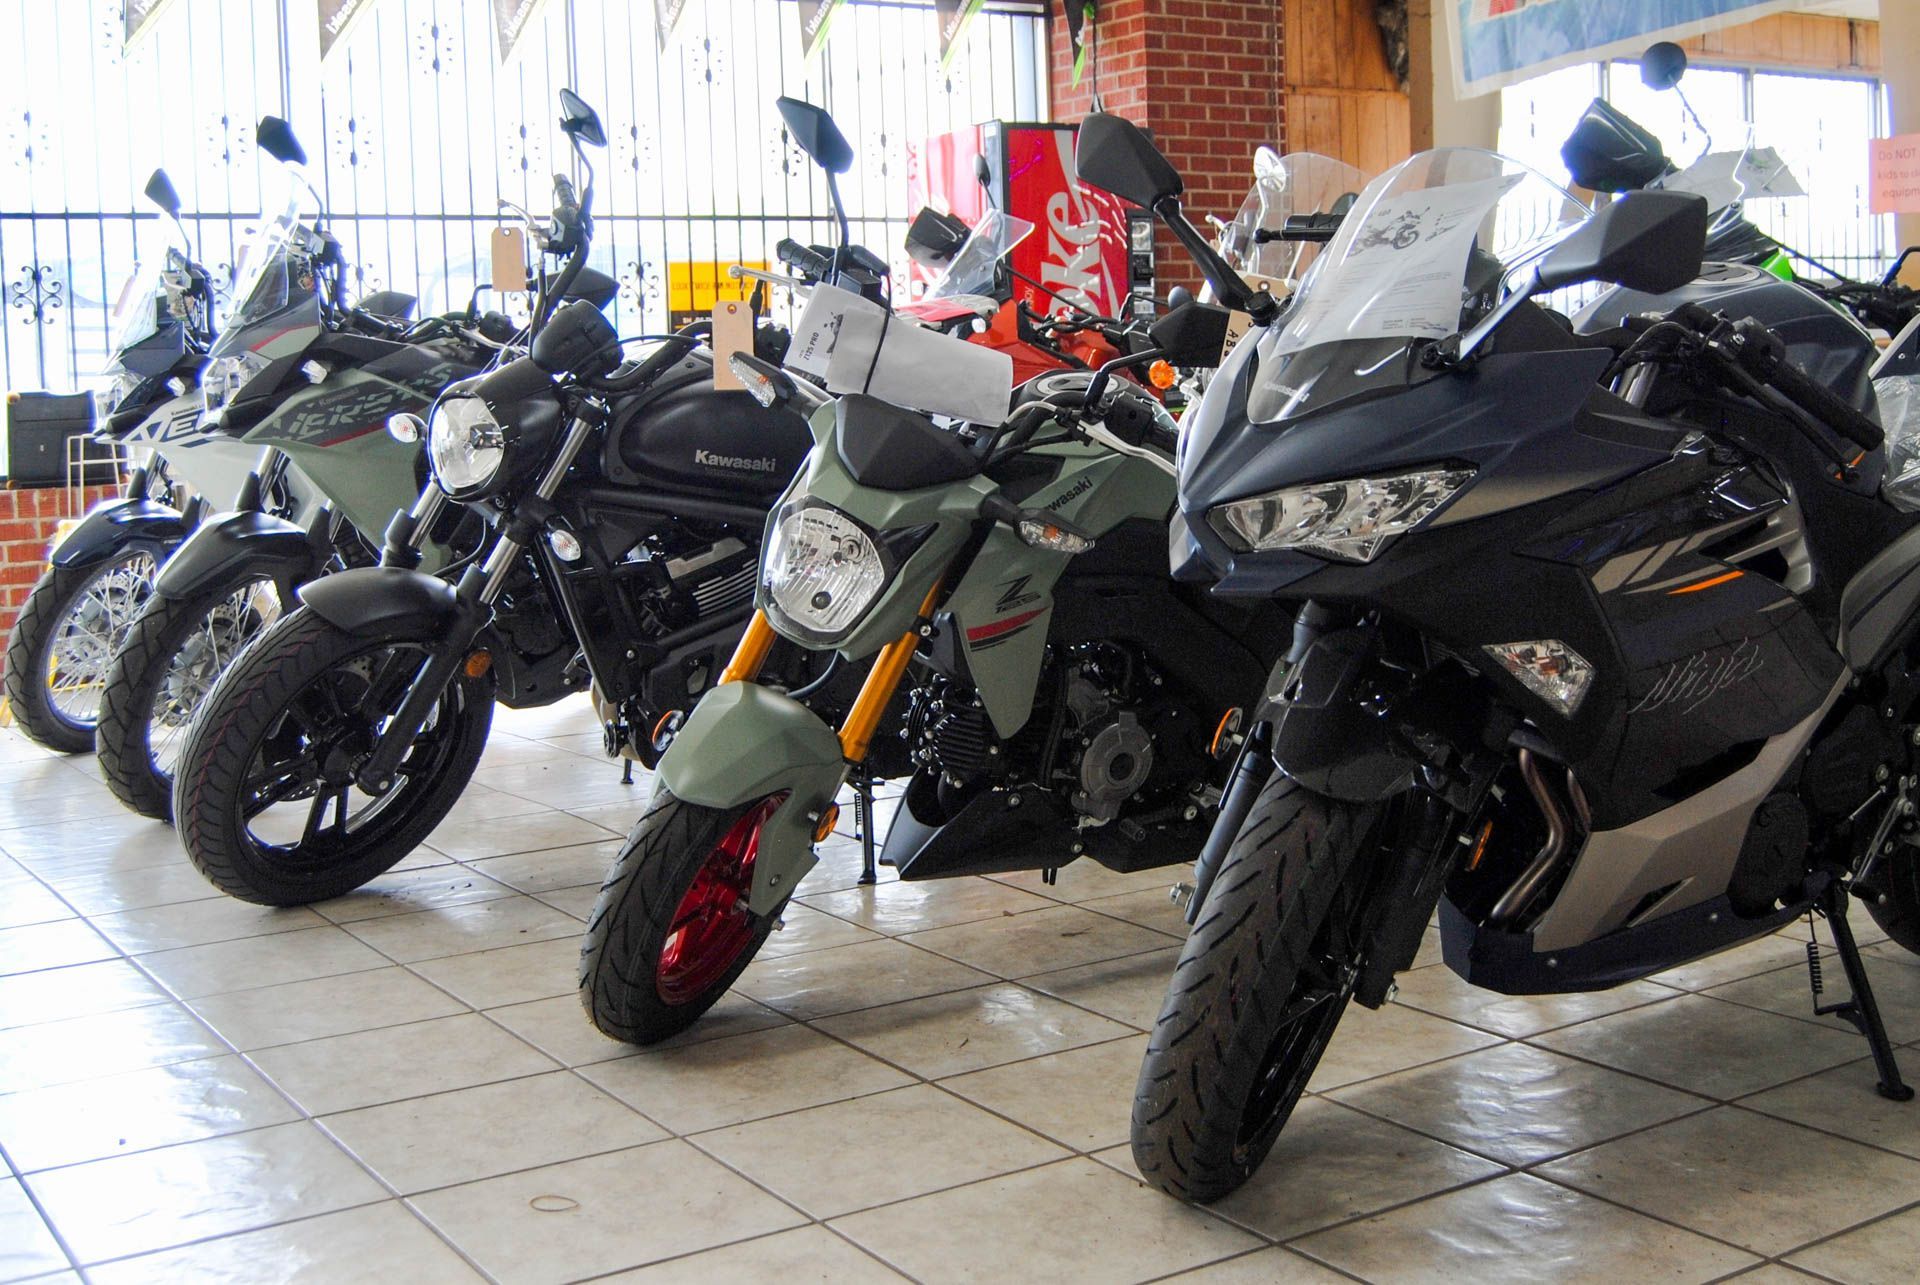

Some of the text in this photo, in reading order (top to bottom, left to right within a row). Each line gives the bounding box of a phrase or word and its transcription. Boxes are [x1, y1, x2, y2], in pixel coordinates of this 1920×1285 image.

[1896, 147, 1916, 159] NOT
[1882, 187, 1920, 199] equipm
[1041, 192, 1101, 318] oke
[695, 449, 777, 473] Kawasaki
[1043, 475, 1094, 511] wasaki
